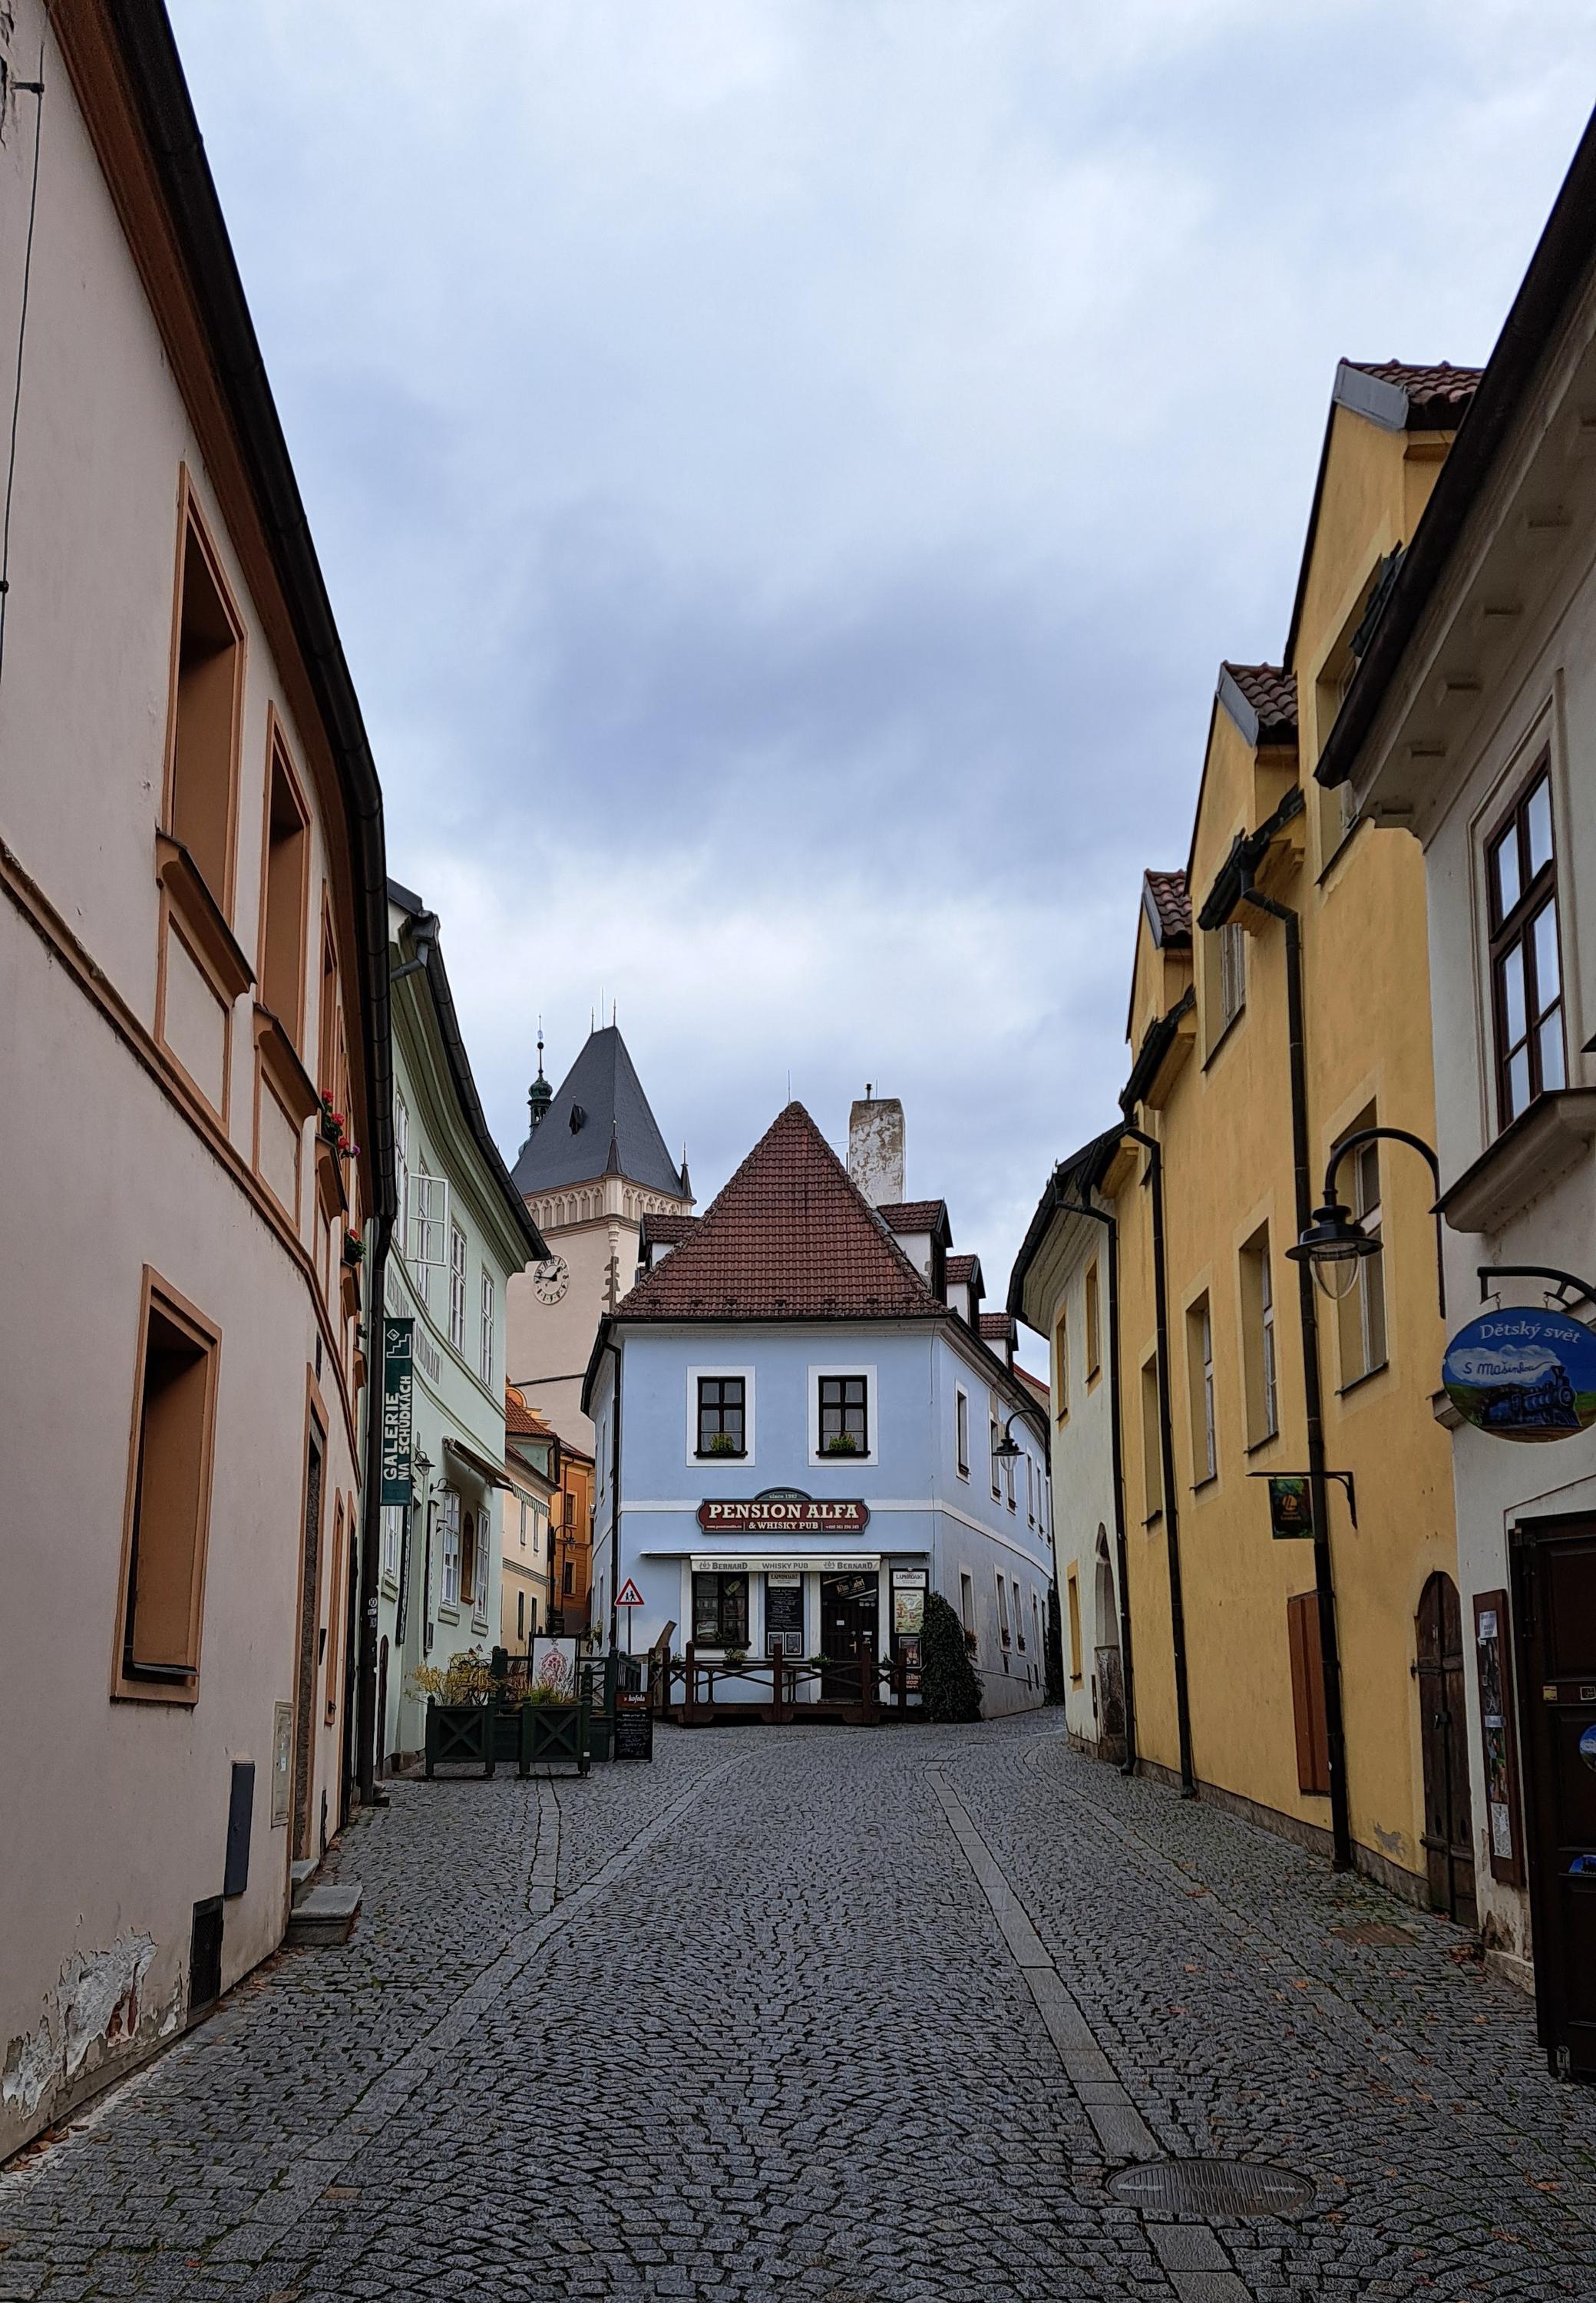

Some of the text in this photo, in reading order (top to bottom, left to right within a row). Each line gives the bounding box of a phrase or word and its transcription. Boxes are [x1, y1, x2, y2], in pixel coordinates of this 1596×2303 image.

[1480, 1321, 1581, 1343] Dětský svět
[384, 1393, 399, 1480] GALERIE
[398, 1462, 410, 1480] NA
[709, 1504, 858, 1518] PENSION ALFA
[712, 1561, 748, 1570] BERNARD
[628, 1694, 646, 1703] kofola
